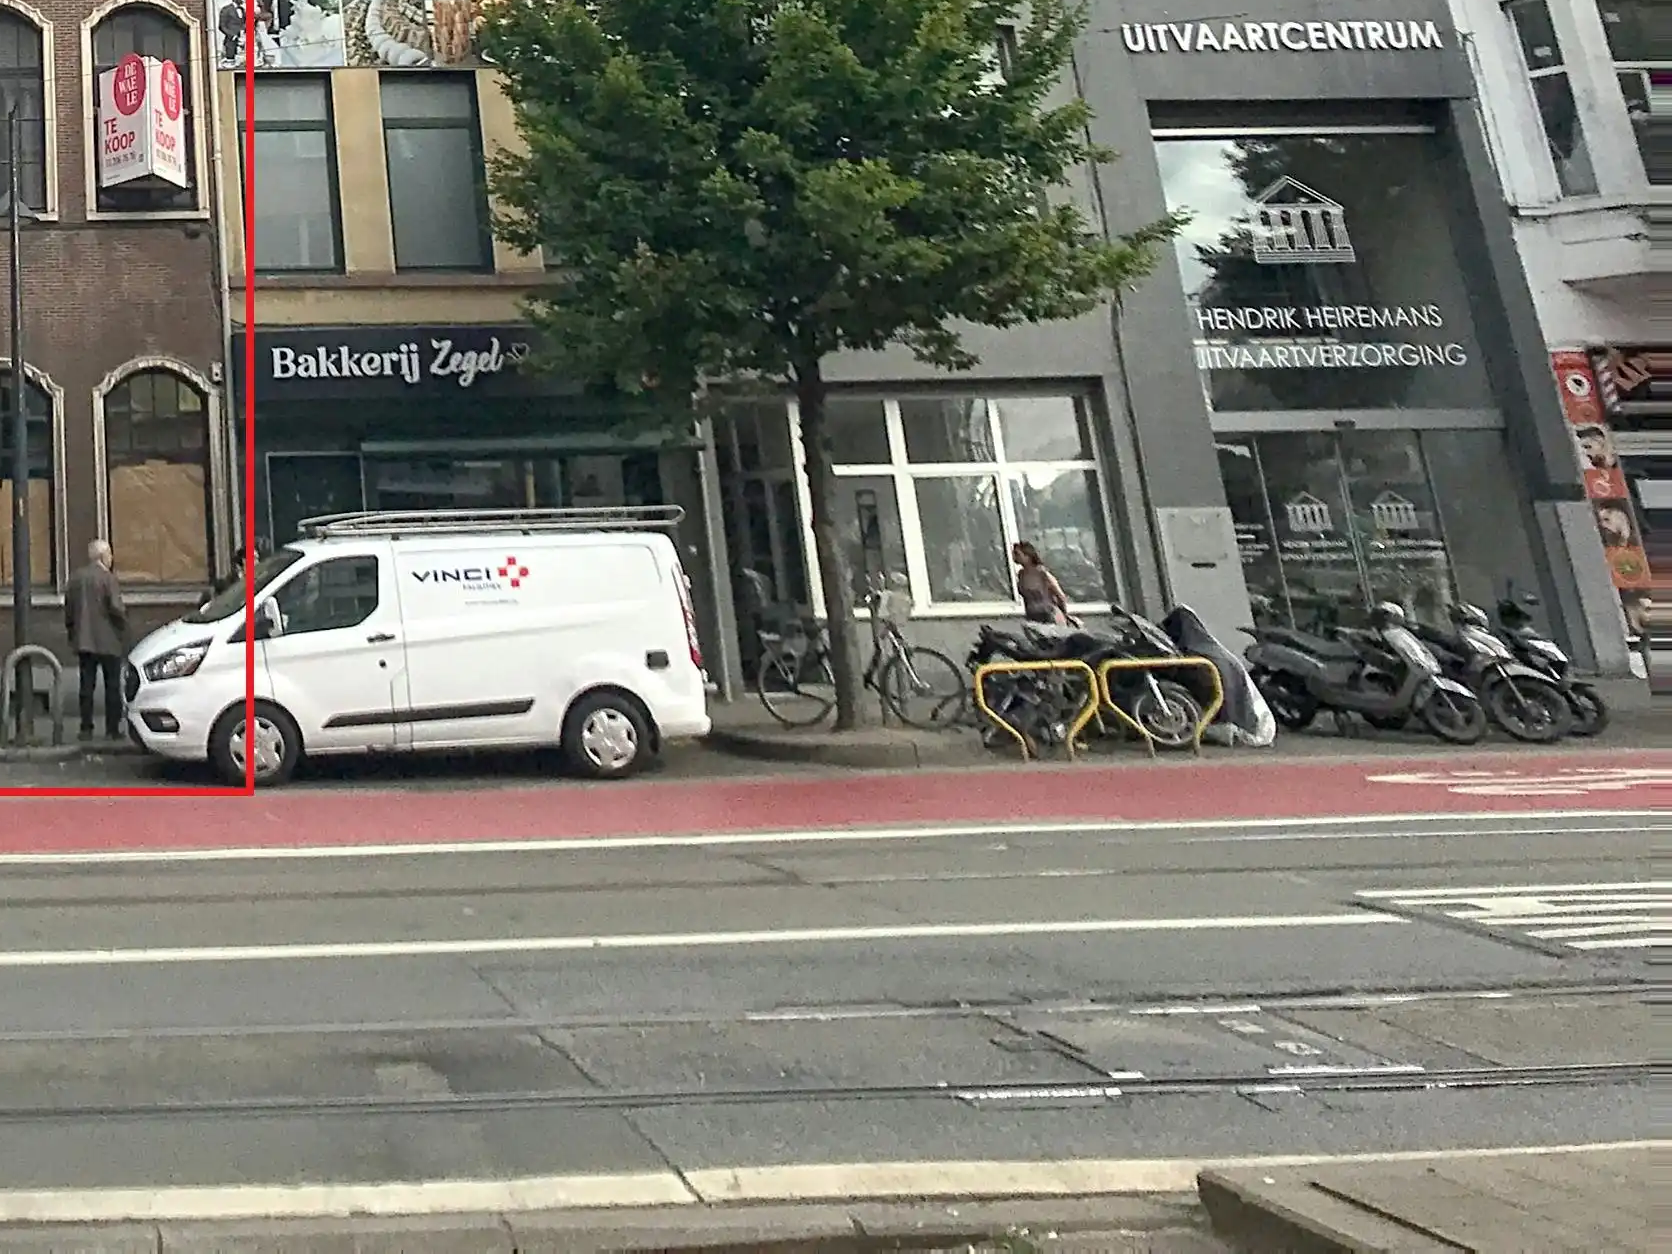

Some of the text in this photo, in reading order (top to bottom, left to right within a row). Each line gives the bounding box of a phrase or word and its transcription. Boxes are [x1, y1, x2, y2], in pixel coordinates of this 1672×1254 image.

[1121, 20, 1444, 52] UITVAARTCENTRUM
[124, 61, 137, 78] DE
[125, 89, 138, 107] LE
[104, 117, 117, 136] TE
[104, 130, 135, 155] KOOP
[1195, 304, 1443, 331] HENDRIK HEIREMANS
[271, 337, 503, 387] Bakkerij Zegel
[1195, 344, 1468, 369] UITVAARTVERZORGING
[411, 567, 492, 583] VINCI
